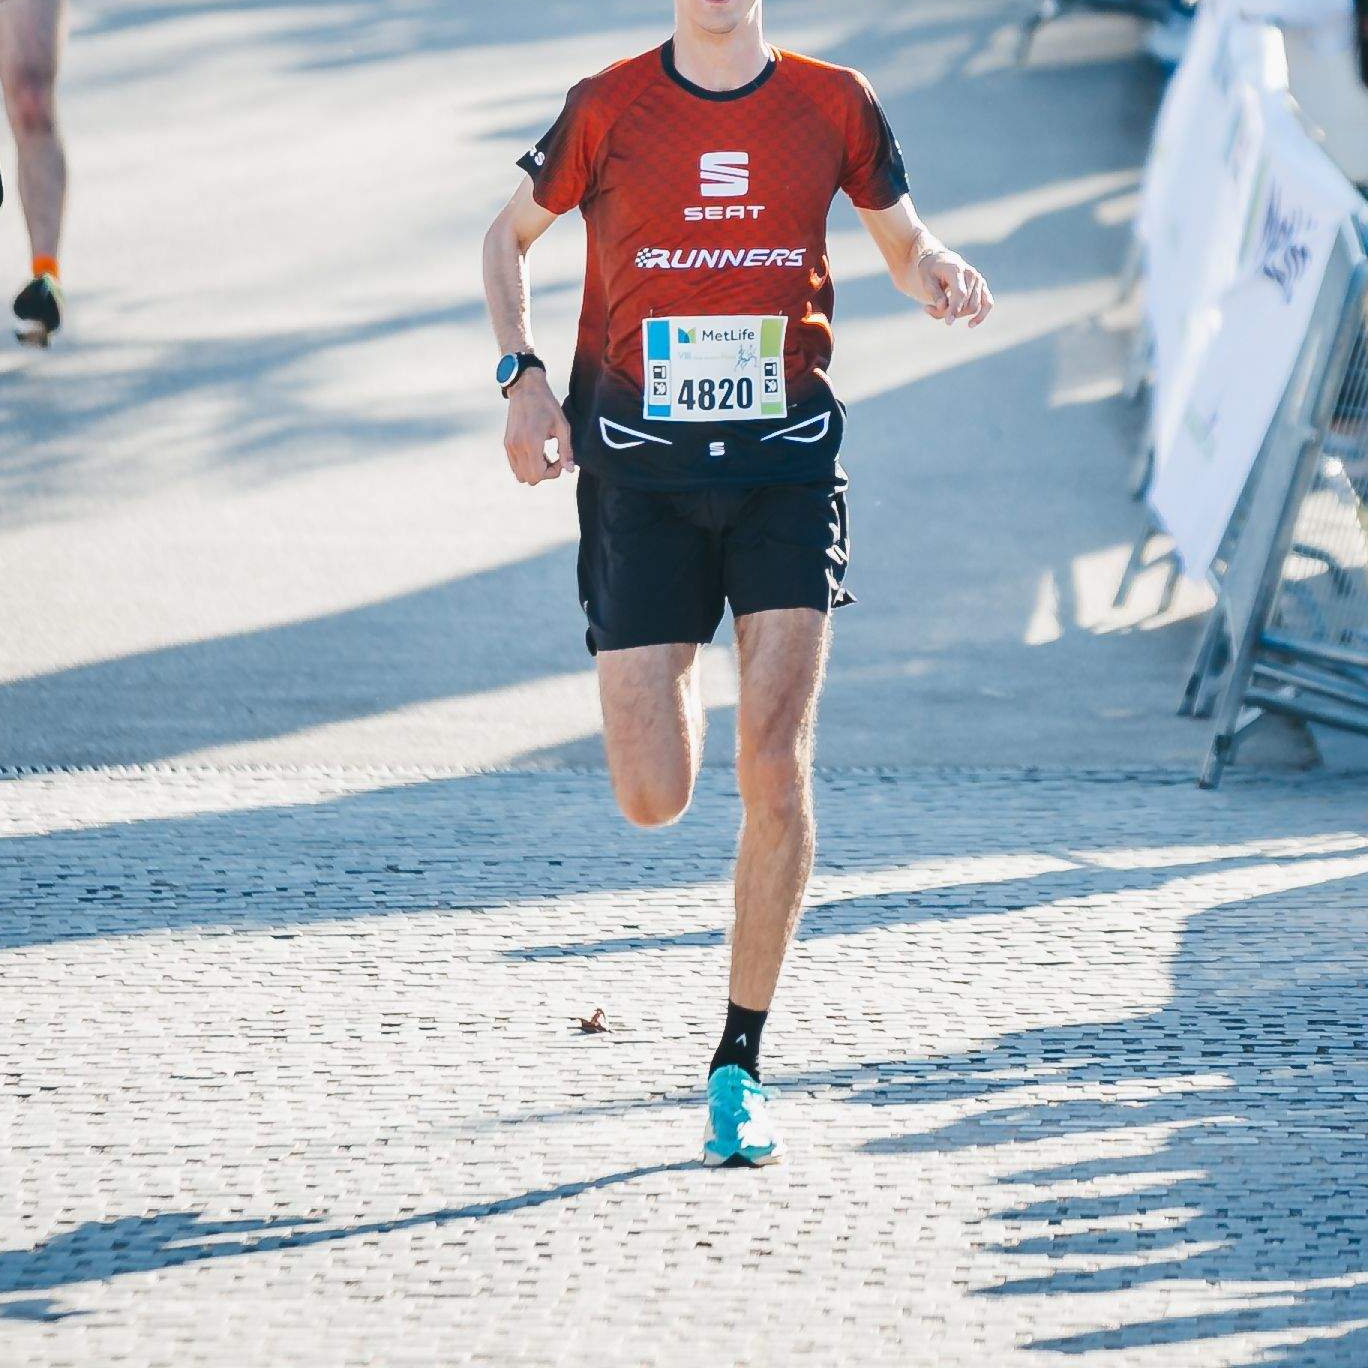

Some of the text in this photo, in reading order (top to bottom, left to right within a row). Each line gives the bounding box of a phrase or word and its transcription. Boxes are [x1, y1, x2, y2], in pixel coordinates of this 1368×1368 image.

[683, 205, 766, 222] SEAT
[635, 247, 807, 269] RUNNERS
[701, 328, 755, 342] MetLife
[677, 377, 754, 411] 4820
